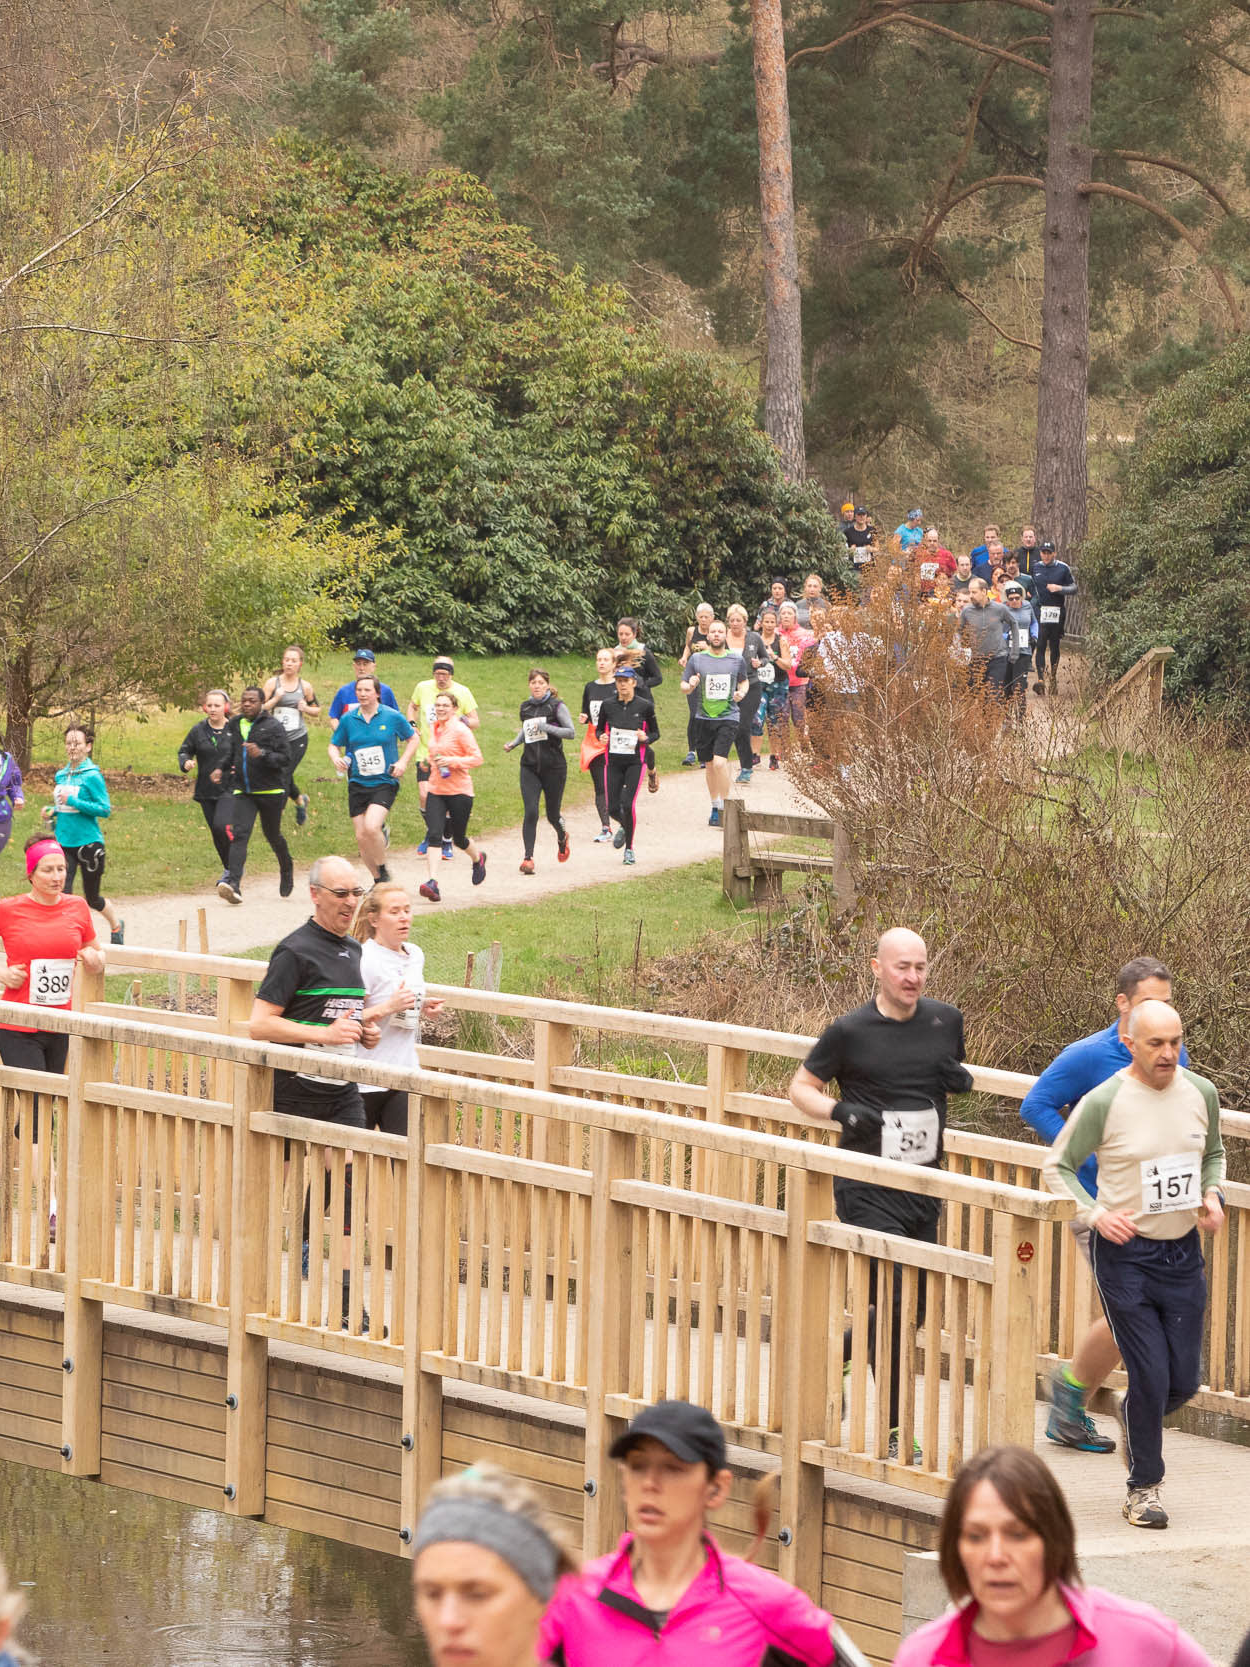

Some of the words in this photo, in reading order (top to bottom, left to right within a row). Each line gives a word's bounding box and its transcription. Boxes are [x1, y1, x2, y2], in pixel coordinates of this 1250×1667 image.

[709, 682, 728, 691] 292
[37, 975, 70, 994] 389
[1152, 1173, 1193, 1200] 157
